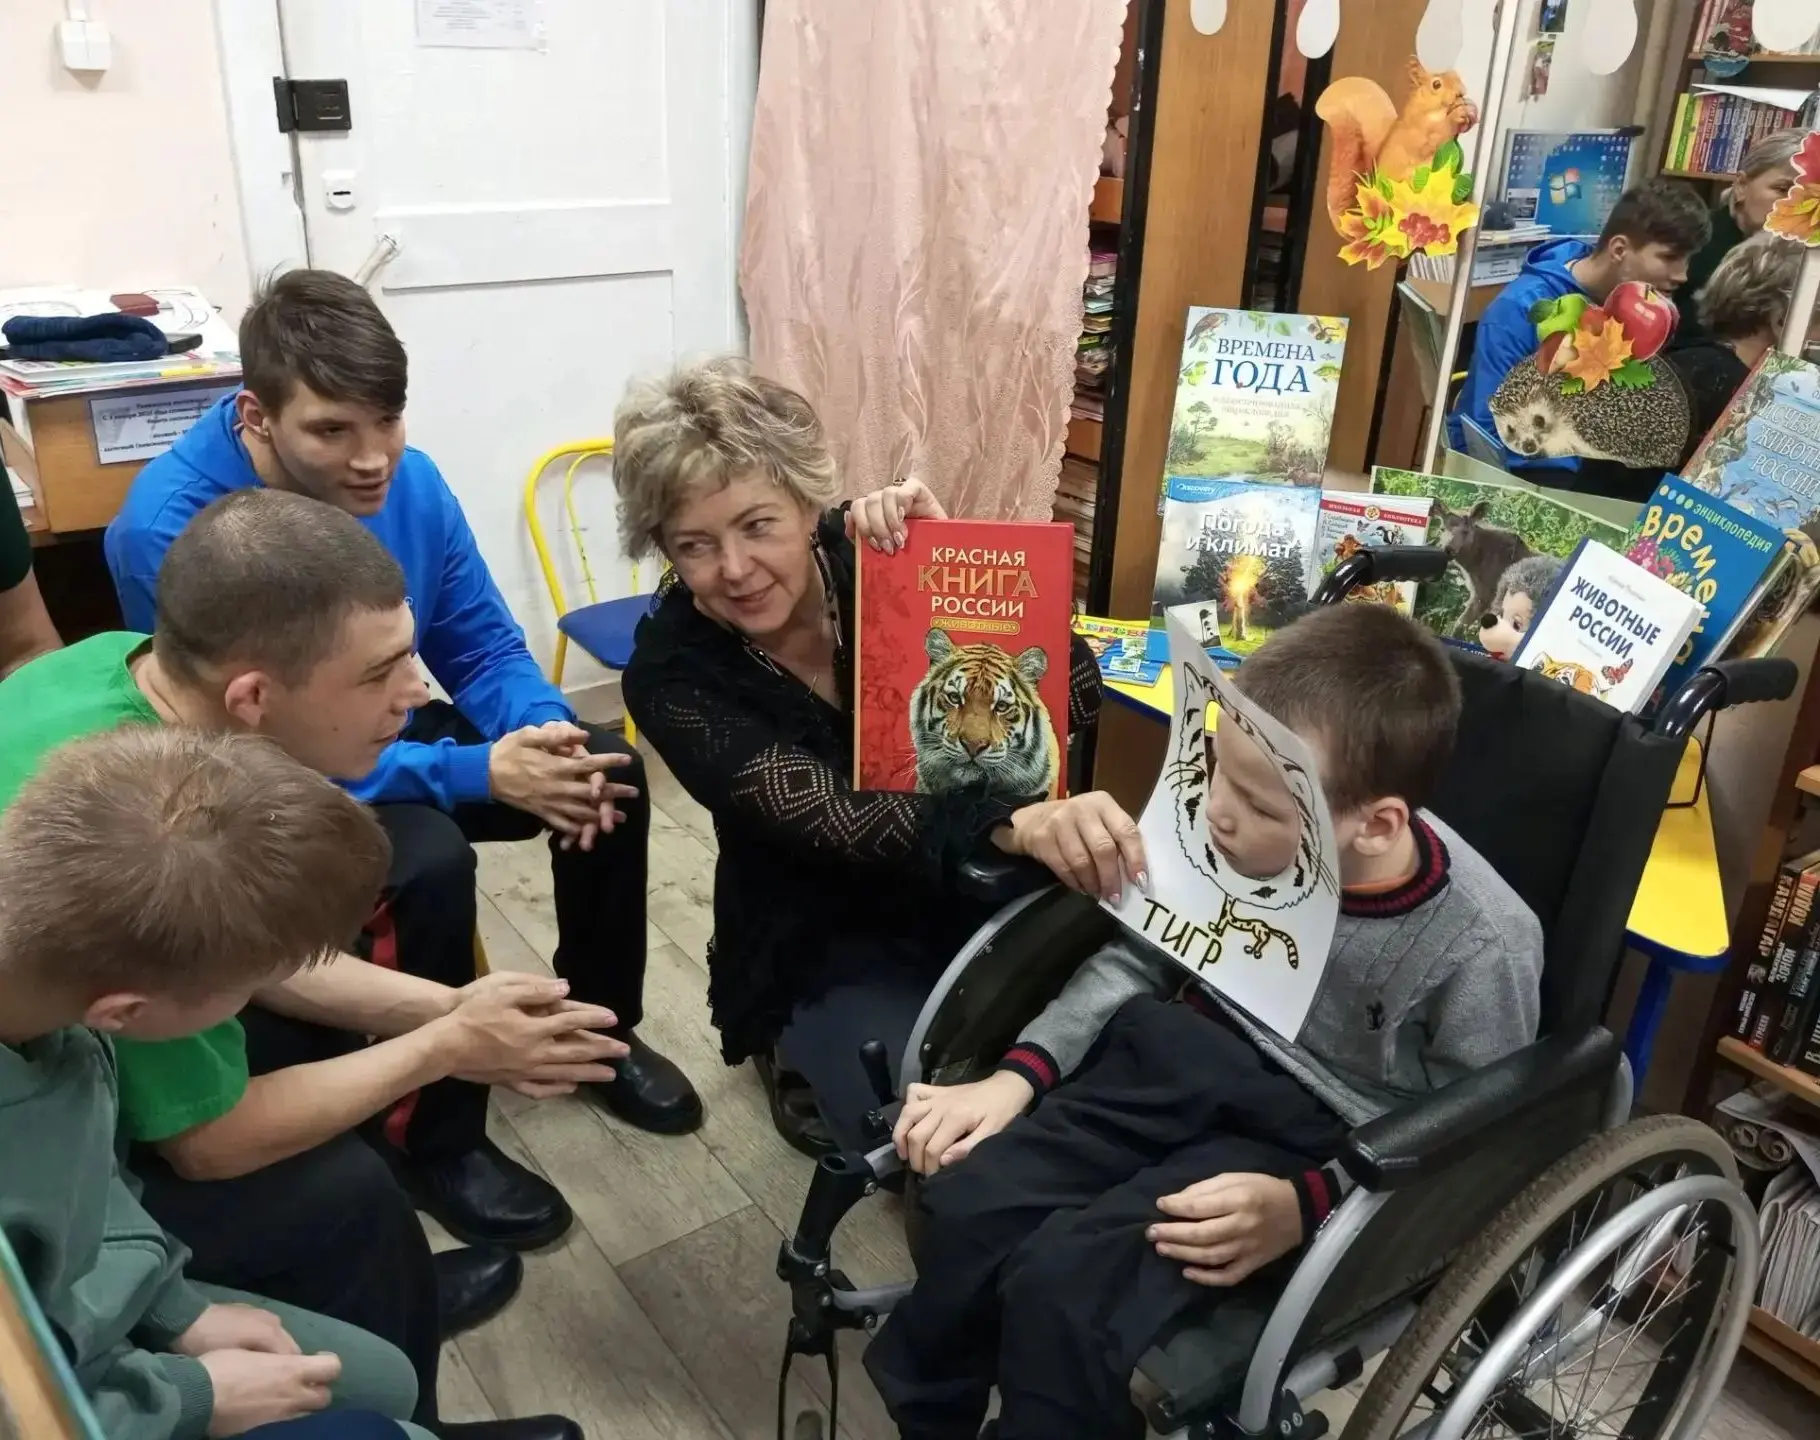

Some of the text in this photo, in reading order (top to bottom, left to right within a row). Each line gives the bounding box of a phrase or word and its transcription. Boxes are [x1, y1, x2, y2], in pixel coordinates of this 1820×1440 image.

[1216, 337, 1317, 362] ВРЕМЕНА
[1211, 358, 1311, 396] ГОДА
[1749, 454, 1820, 499] РОССИИ
[1200, 512, 1290, 539] Погода
[931, 546, 1026, 567] КРАСНАЯ
[1185, 536, 1296, 559] и климат
[917, 564, 1039, 598] КНИГА
[931, 595, 1024, 618] РОССИИ
[1570, 576, 1661, 646] ЖИВОТНЫЕ
[1568, 605, 1634, 659] РОССИИ
[1758, 874, 1794, 957] КАНДАГАР
[1143, 897, 1223, 972] ТИГР
